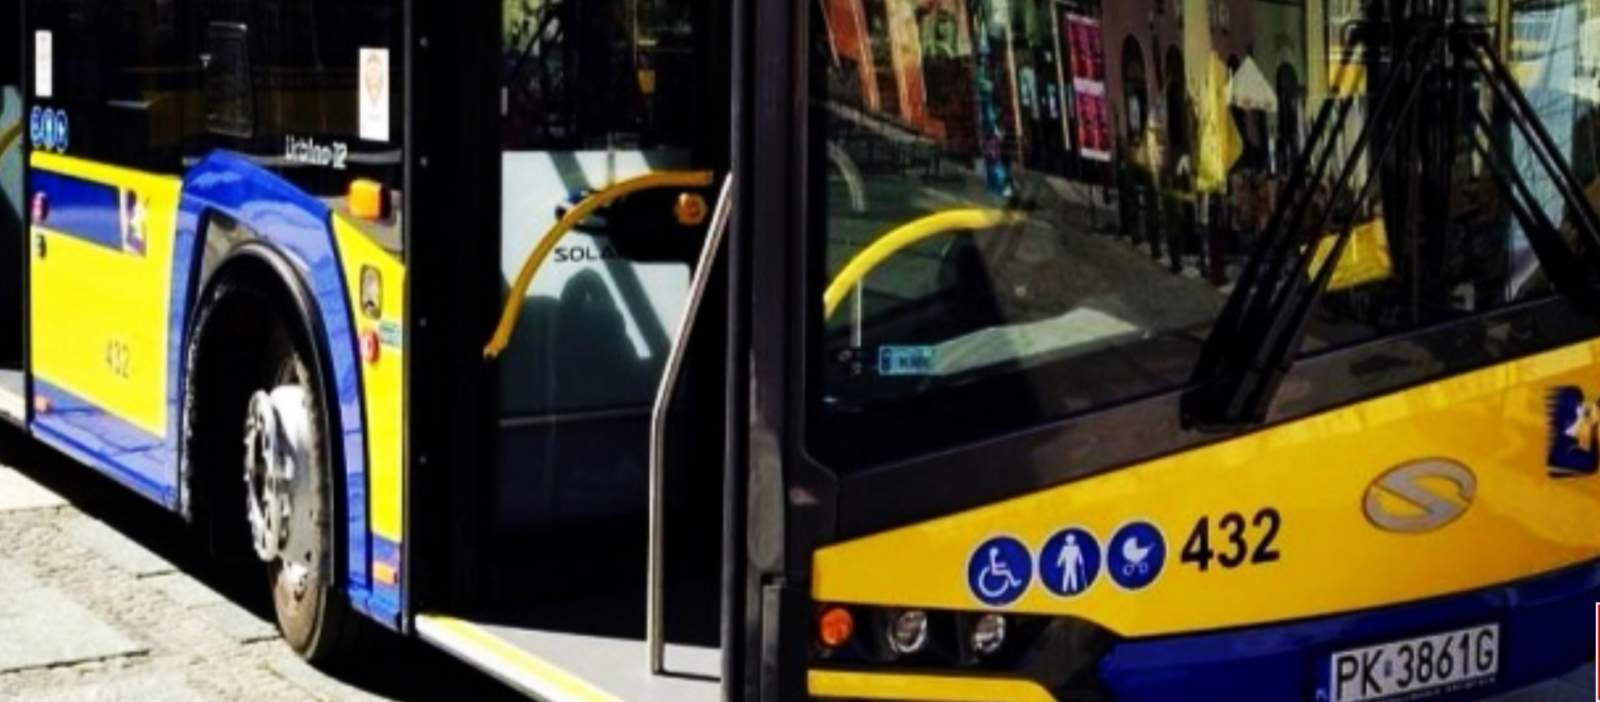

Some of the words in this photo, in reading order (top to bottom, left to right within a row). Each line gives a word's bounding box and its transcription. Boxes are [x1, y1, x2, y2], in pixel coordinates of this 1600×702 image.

[1180, 507, 1281, 571] 432
[1336, 648, 1383, 701] PK
[1396, 629, 1495, 688] 3861G
